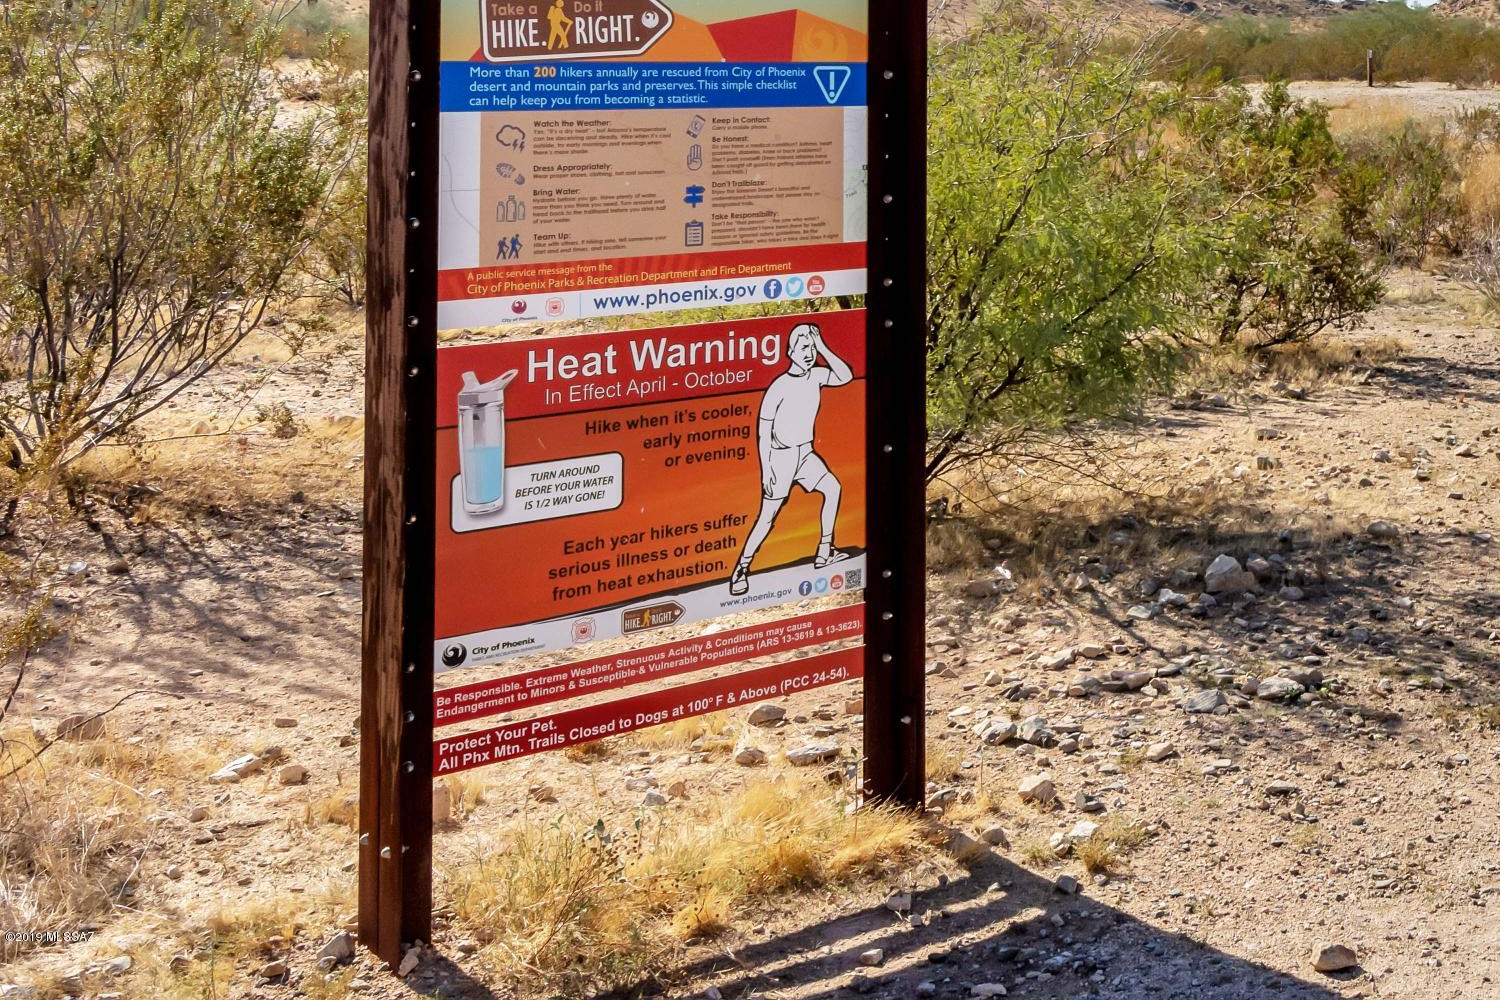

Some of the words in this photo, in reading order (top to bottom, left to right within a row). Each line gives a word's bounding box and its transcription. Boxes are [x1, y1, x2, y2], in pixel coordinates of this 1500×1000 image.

[491, 3, 525, 16] Take
[529, 5, 538, 15] a
[574, 1, 591, 13] Do
[595, 0, 603, 12] it
[491, 19, 547, 49] HIKE.
[575, 14, 640, 44] RIGHT.
[469, 67, 500, 77] More
[505, 67, 529, 77] than
[534, 67, 556, 78] 200
[560, 67, 592, 77] hikers
[596, 67, 638, 80] annually
[662, 67, 701, 76] rescued
[705, 67, 728, 77] from
[732, 67, 752, 79] City
[755, 67, 765, 76] of
[769, 67, 806, 77] Phoenix
[469, 81, 506, 92] desert
[510, 81, 530, 91] and
[535, 81, 586, 91] mountain
[590, 81, 619, 93] parks
[622, 80, 641, 90] and
[645, 80, 696, 93] preserves.
[698, 80, 718, 90] This
[722, 80, 752, 92] simple
[756, 80, 797, 90] checklist
[469, 98, 489, 106] can
[493, 95, 517, 108] help
[521, 95, 547, 108] keep
[551, 97, 571, 107] you
[575, 94, 600, 104] from
[605, 94, 655, 106] becoming
[668, 94, 708, 103] statistic.
[467, 284, 488, 295] City
[491, 282, 501, 292] of
[504, 280, 545, 291] Phoenix
[549, 278, 574, 288] Parks
[577, 277, 584, 285] &
[587, 274, 638, 285] Recreation
[642, 269, 698, 283] Department
[700, 267, 717, 277] and
[720, 266, 736, 274] Fire
[738, 262, 791, 276] Department
[477, 270, 502, 281] public
[506, 269, 536, 278] service
[538, 267, 574, 276] message
[594, 284, 756, 310] www.phoenix.gov
[528, 343, 617, 383] Heat
[630, 331, 781, 371] Warning
[545, 387, 562, 405] In
[570, 381, 621, 402] Effect
[627, 377, 666, 396] April
[685, 368, 752, 389] October
[586, 419, 621, 435] Hike
[627, 413, 669, 430] when
[674, 410, 696, 423] it's
[702, 404, 752, 420] cooler,
[643, 431, 682, 449] early
[687, 425, 750, 443] morning
[665, 455, 680, 468] or
[685, 447, 750, 465] evening.
[531, 471, 556, 482] TURN
[558, 464, 600, 478] AROUND
[515, 485, 552, 498] BEFORE
[555, 481, 580, 492] YOUR
[583, 476, 614, 488] WATER
[524, 501, 533, 510] IS
[536, 499, 550, 508] 1/2
[553, 495, 573, 506] WAY
[575, 490, 605, 502] GONE!
[564, 536, 605, 555] Each
[610, 532, 644, 551] year
[650, 522, 698, 541] hikers
[703, 514, 748, 531] suffer
[548, 559, 610, 580] serious
[616, 550, 668, 568] illness
[674, 545, 689, 558] or
[694, 535, 737, 553] death
[553, 584, 591, 601] from
[597, 575, 632, 593] heat
[637, 558, 727, 585] exhaustion.
[720, 588, 792, 608] www.phoenix.gov
[652, 611, 673, 624] RIGHT.
[491, 643, 500, 651] of
[502, 637, 535, 649] Phoenix
[437, 697, 451, 706] Be
[455, 682, 523, 704] Responsible.
[526, 672, 568, 688] Extreme
[571, 663, 614, 678] Weather,
[616, 648, 666, 667] Strenuous
[668, 643, 702, 658] Activity
[706, 639, 713, 648] &
[715, 631, 764, 648] Conditions
[766, 627, 785, 639] may
[787, 621, 812, 632] cause
[437, 695, 514, 719] Endangerment
[517, 692, 528, 700] to
[531, 684, 566, 698] Minors
[569, 681, 576, 689] &
[639, 666, 646, 675] &
[649, 655, 698, 671] Vulnerable
[701, 644, 755, 661] Populations
[757, 635, 779, 650] (ARS
[782, 630, 814, 643] 13-3619
[817, 626, 823, 636] &
[826, 620, 862, 635] 13-3623).
[439, 755, 458, 771] All
[463, 750, 490, 766] Phx
[494, 744, 523, 759] Mtn.
[528, 733, 565, 750] Trails
[569, 720, 615, 741] Closed
[619, 718, 632, 728] to
[636, 710, 669, 727] Dogs
[672, 704, 684, 716] at
[716, 695, 723, 706] F
[727, 693, 736, 704] &
[739, 684, 777, 701] Above
[781, 676, 810, 694] (PCC
[812, 666, 849, 684] 24-54).
[439, 732, 491, 755] Protect
[495, 727, 527, 742] Your
[531, 720, 557, 735] Pet.
